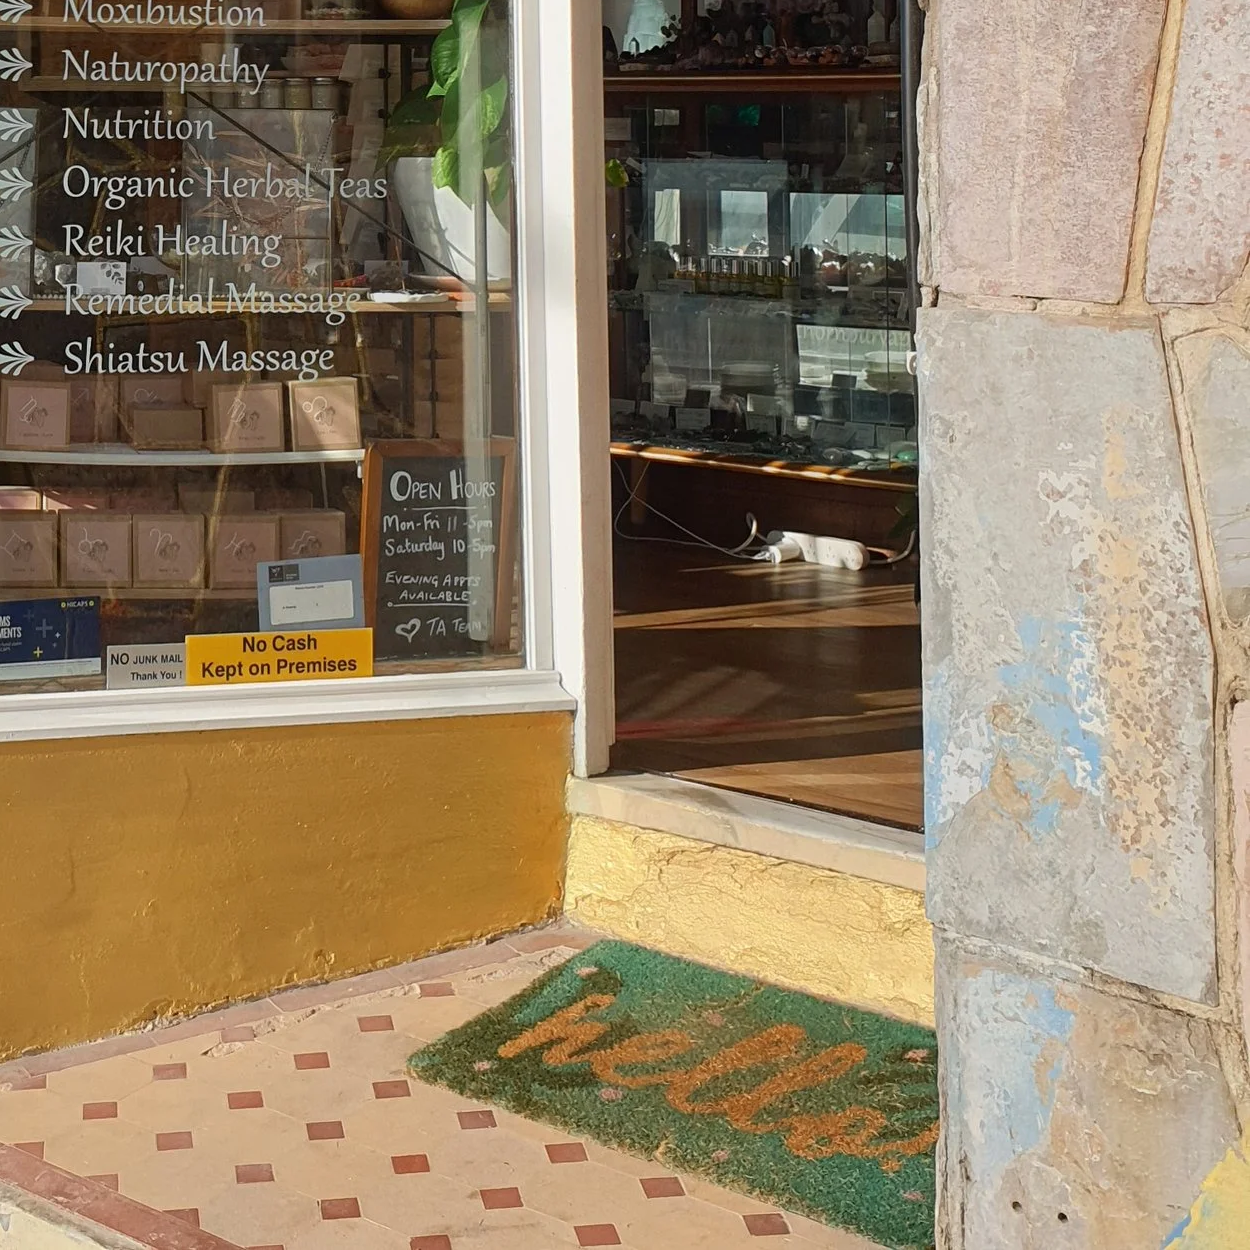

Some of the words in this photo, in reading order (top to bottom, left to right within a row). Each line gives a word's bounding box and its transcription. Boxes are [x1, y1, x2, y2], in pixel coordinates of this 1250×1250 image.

[62, 47, 269, 94] Naturopathy
[62, 107, 216, 141] Nutrition
[62, 164, 194, 210] Organic
[205, 162, 314, 199] Herbal
[320, 166, 388, 199] Teas
[62, 219, 146, 256] Reiki
[156, 222, 282, 267] Healing
[63, 282, 217, 316] Remedial
[225, 283, 361, 325] Massage
[64, 337, 186, 375] Shiatsu
[196, 340, 335, 382] Massage
[390, 470, 442, 501] OPEN
[449, 468, 496, 501] HOURS
[383, 512, 440, 533] Mon-Fri
[385, 535, 445, 561] Saturday
[385, 571, 439, 588] EVENING
[443, 574, 481, 587] APPTS
[66, 600, 88, 608] HICAPS
[399, 589, 471, 602] AVAILABLE
[426, 617, 446, 636] TA
[452, 617, 482, 634] TEAM
[242, 636, 267, 653] No
[271, 634, 317, 651] Cash
[110, 652, 129, 666] NO
[132, 654, 158, 665] JUNK
[160, 654, 183, 664] MAIL
[201, 661, 243, 681] Kept
[249, 662, 271, 677] on
[277, 658, 358, 675] Premises
[131, 671, 158, 682] Thank
[160, 671, 177, 680] You
